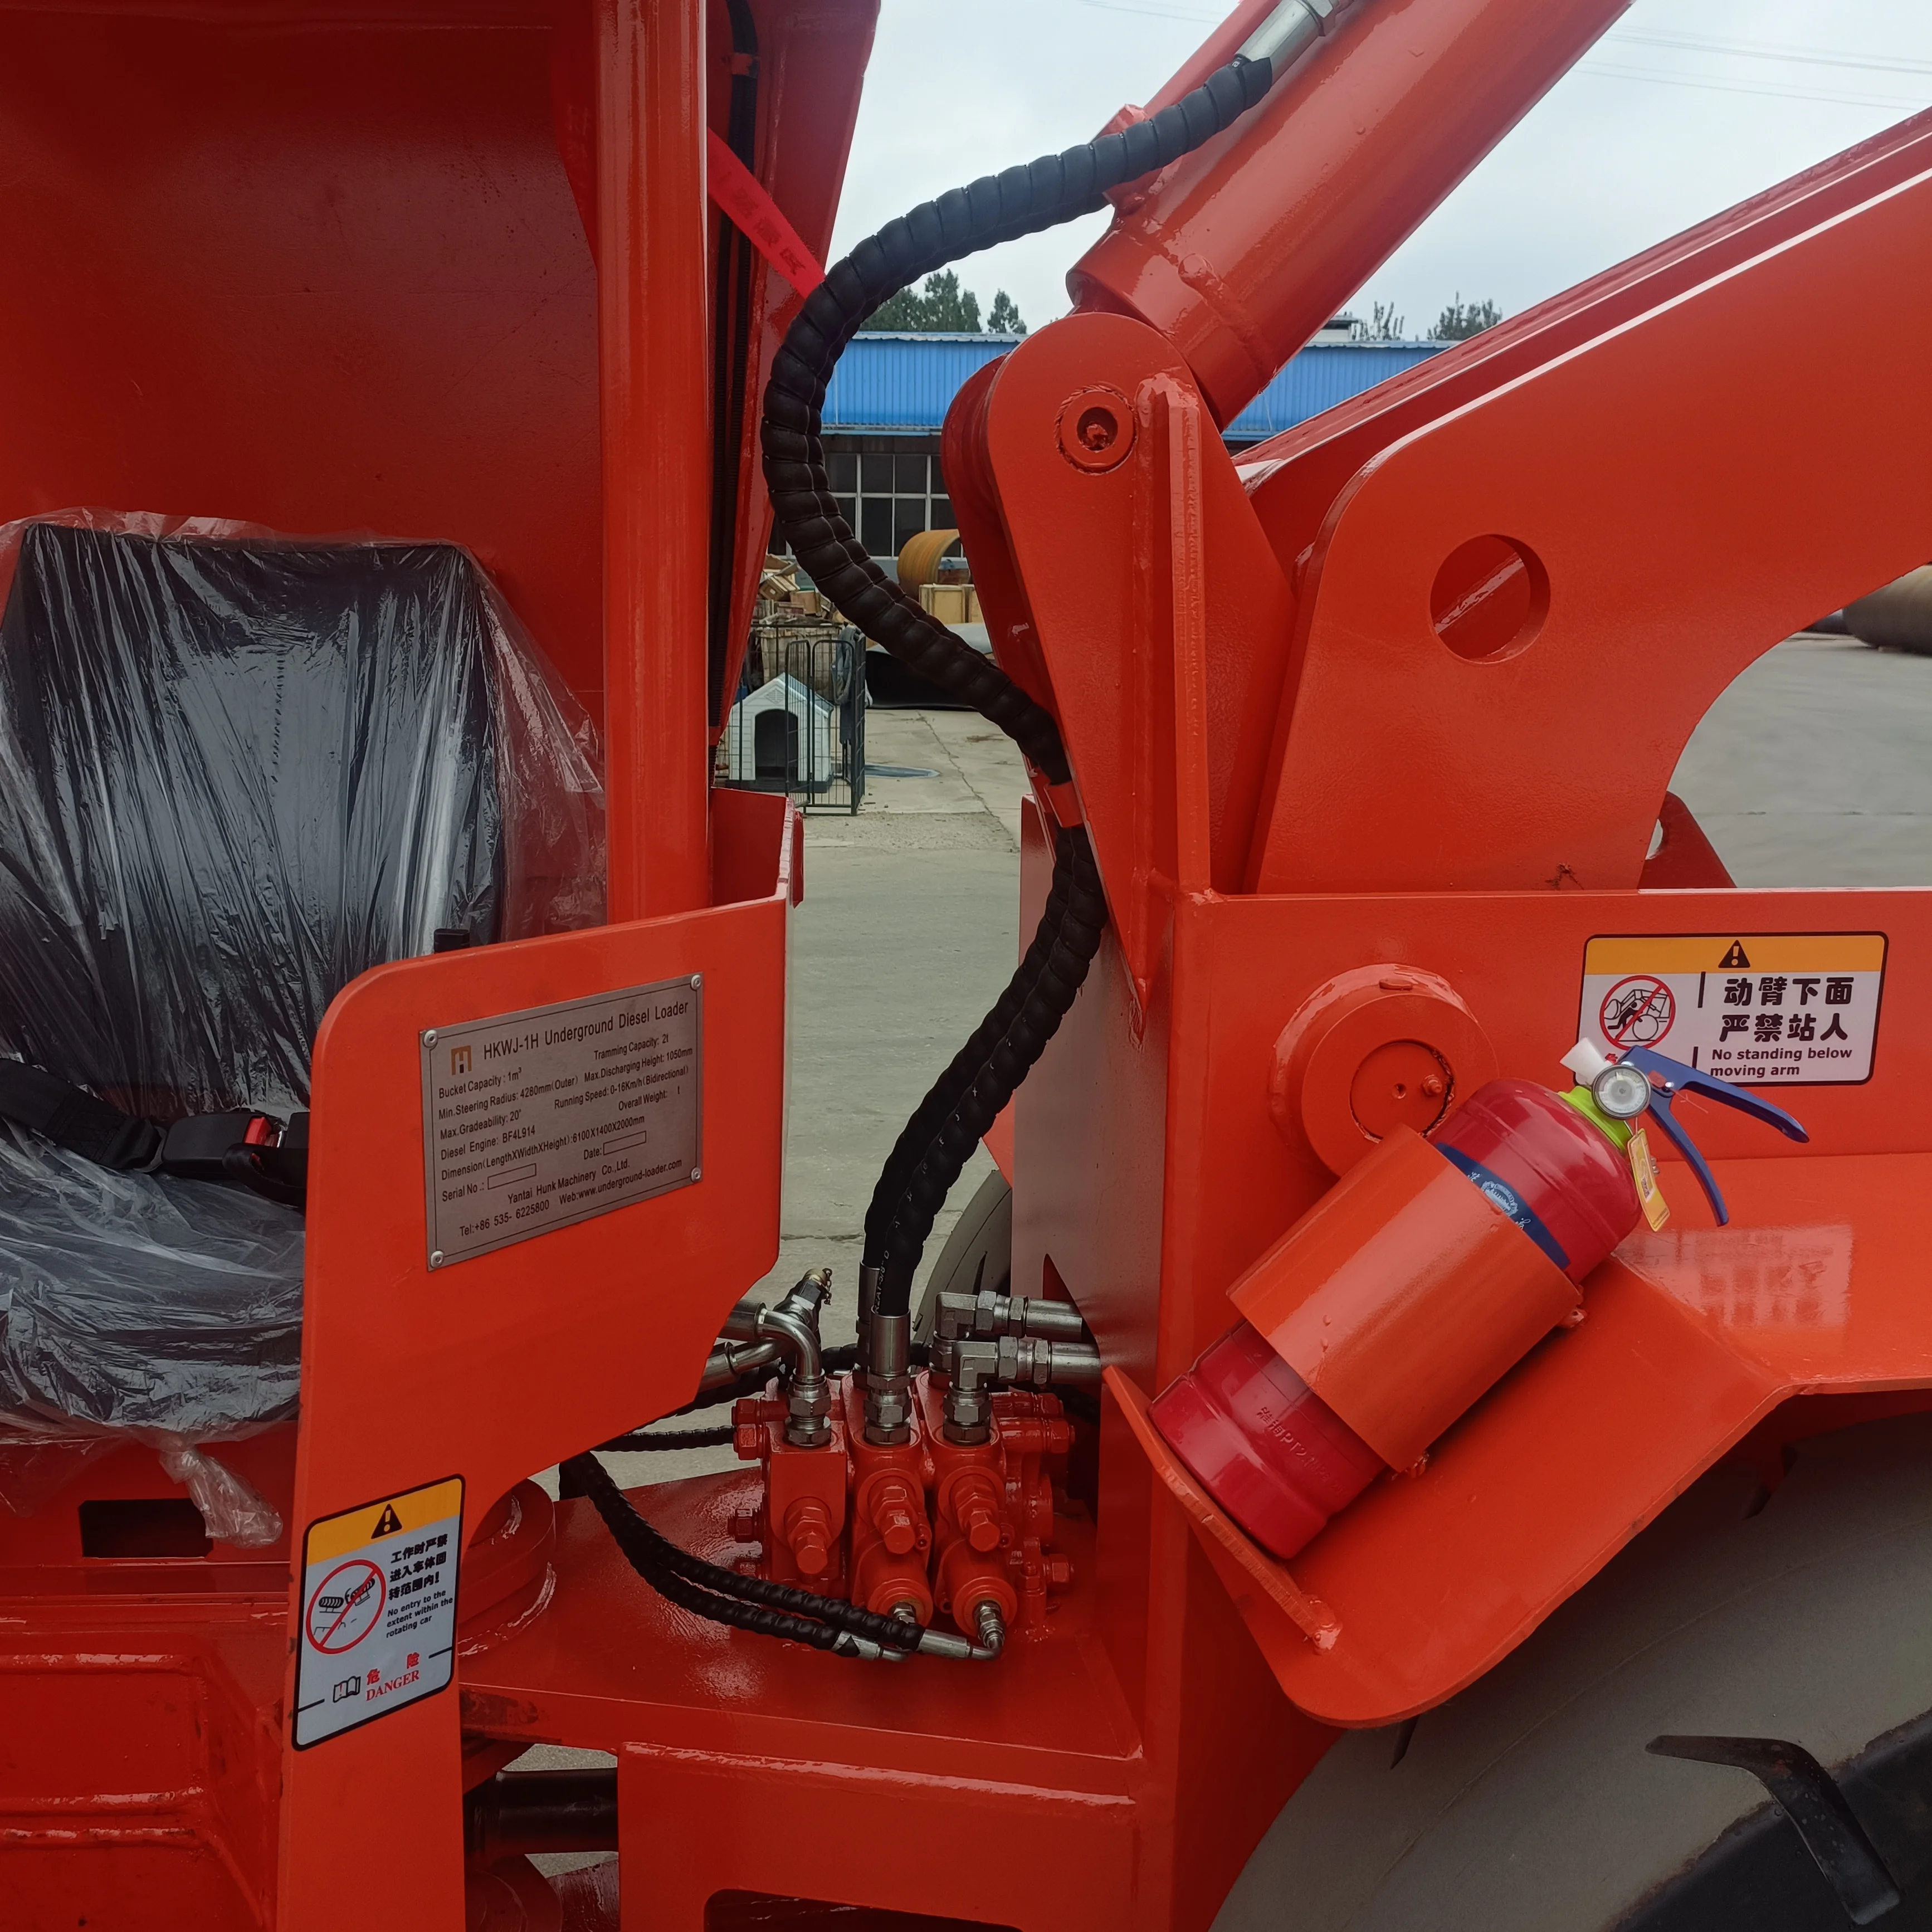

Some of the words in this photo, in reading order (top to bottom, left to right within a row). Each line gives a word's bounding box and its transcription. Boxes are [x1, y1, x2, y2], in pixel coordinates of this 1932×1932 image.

[1724, 977, 1854, 1006] 动臂下面
[484, 1033, 539, 1060] HKWJ-1H
[545, 1016, 613, 1045] Underground
[619, 1008, 650, 1028] Diesel
[655, 1002, 688, 1020] Loader
[1719, 1013, 1848, 1042] 严禁站人
[594, 1045, 627, 1060] Tramming
[628, 1037, 659, 1052] Capacity:
[662, 1033, 669, 1043] 2t
[1712, 1049, 1731, 1060] No
[1737, 1048, 1802, 1061] standing
[1808, 1047, 1852, 1058] below
[584, 1061, 640, 1082] Max.Discharging
[642, 1055, 665, 1067] Height:
[666, 1047, 693, 1061] 1050mm
[1710, 1065, 1765, 1078] moving
[1770, 1066, 1800, 1076] arm
[439, 1082, 466, 1099] Bucket
[554, 1093, 583, 1109] Running
[585, 1087, 609, 1102] Speed:
[618, 1096, 642, 1110] Overall
[643, 1089, 667, 1104] Weight:
[439, 1099, 488, 1120] Min.Steering
[490, 1092, 519, 1106] Radius:
[440, 1115, 508, 1140] Max.Gradeability:
[441, 1144, 466, 1160] Diesel
[470, 1137, 499, 1152] Engine:
[502, 1125, 535, 1143] BF4L914
[584, 1146, 602, 1160] Date:
[442, 1186, 465, 1202] Serial
[508, 1188, 533, 1204] Yantai
[536, 1182, 556, 1196] Hunk
[558, 1170, 596, 1189] Machinery
[516, 1199, 549, 1219] 6225800
[391, 1534, 448, 1564] 工作时严禁
[390, 1551, 446, 1582] 进入车体回
[387, 1608, 398, 1617] No
[401, 1599, 421, 1612] entry
[433, 1590, 446, 1599] the
[387, 1613, 412, 1627] extent
[414, 1603, 438, 1617] within
[441, 1597, 453, 1606] the
[386, 1621, 417, 1638] rotating
[420, 1615, 432, 1624] car
[366, 1670, 419, 1701] DANGER
